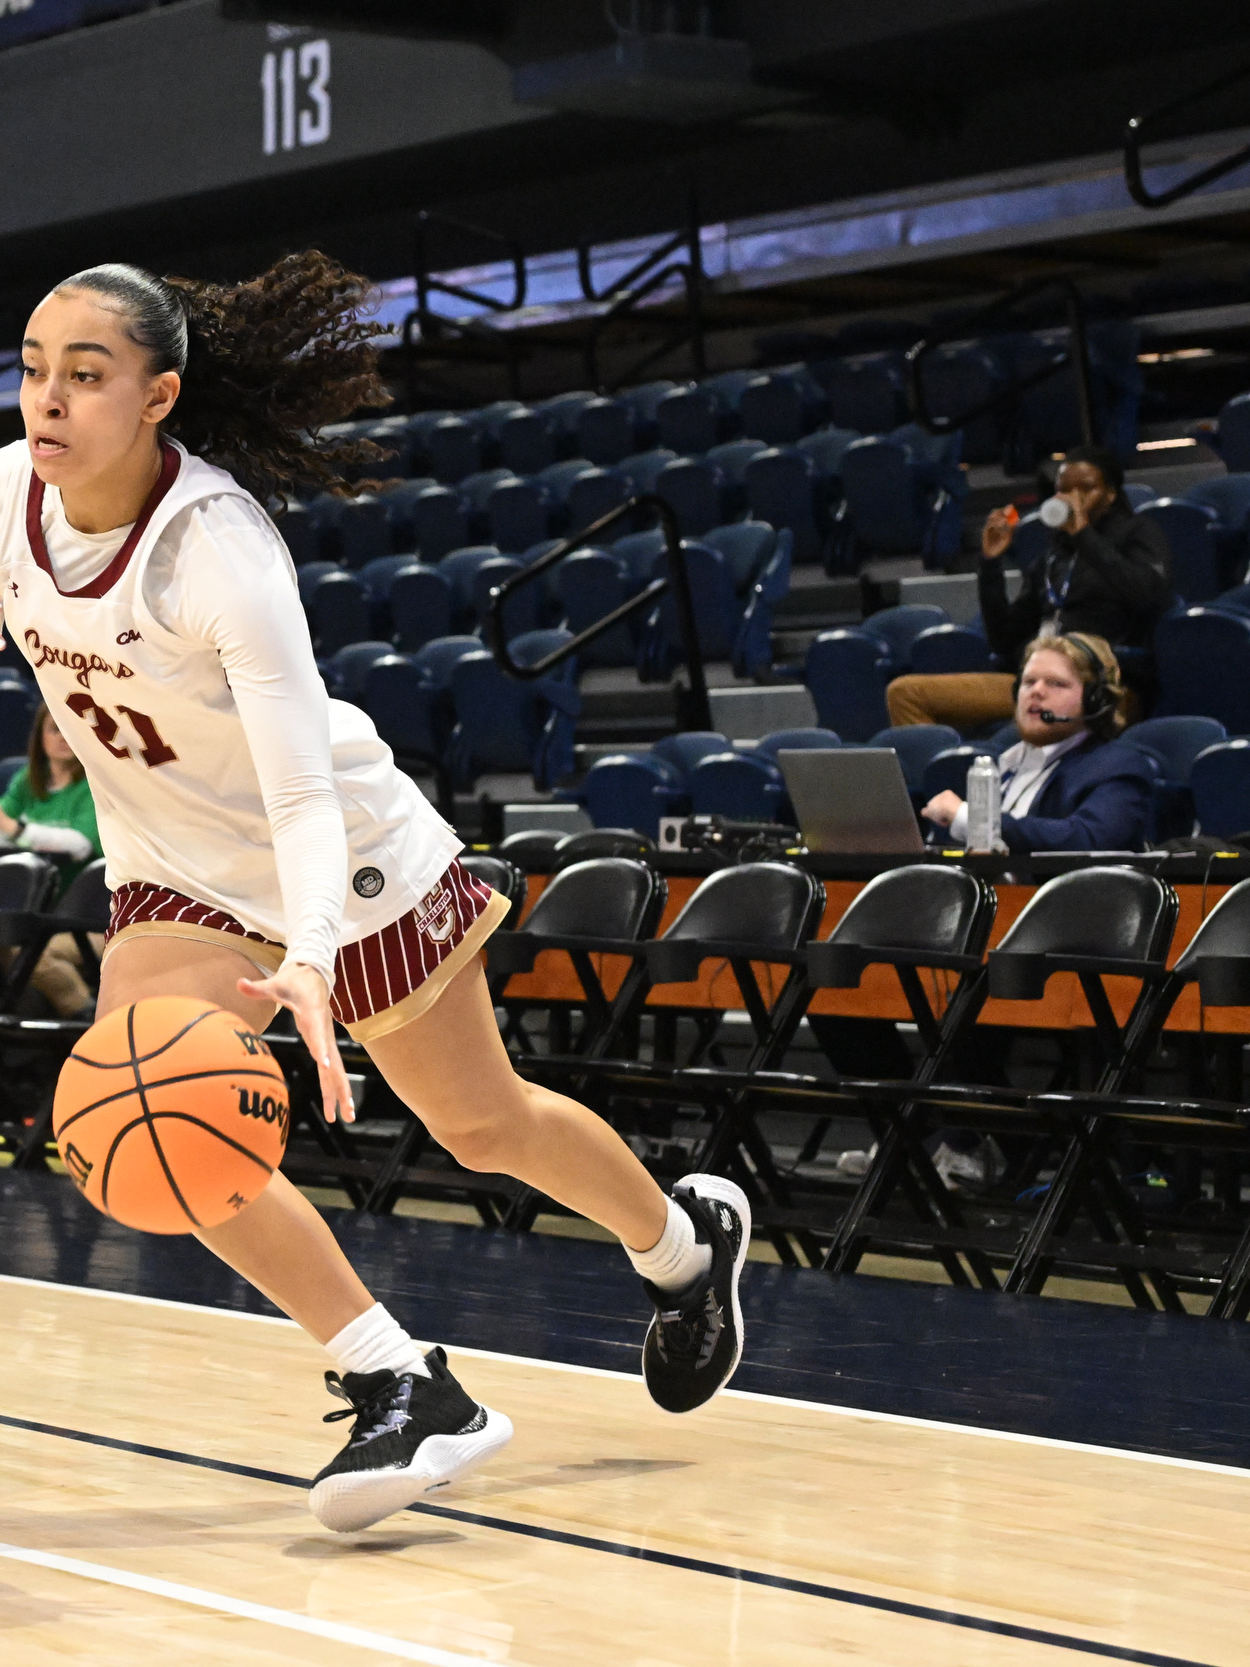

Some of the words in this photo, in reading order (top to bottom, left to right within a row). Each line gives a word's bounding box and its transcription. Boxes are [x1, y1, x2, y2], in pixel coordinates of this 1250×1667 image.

[260, 38, 332, 156] 113
[24, 628, 136, 690] Cougars
[64, 691, 180, 770] 21
[417, 890, 451, 931] CHARLESTON
